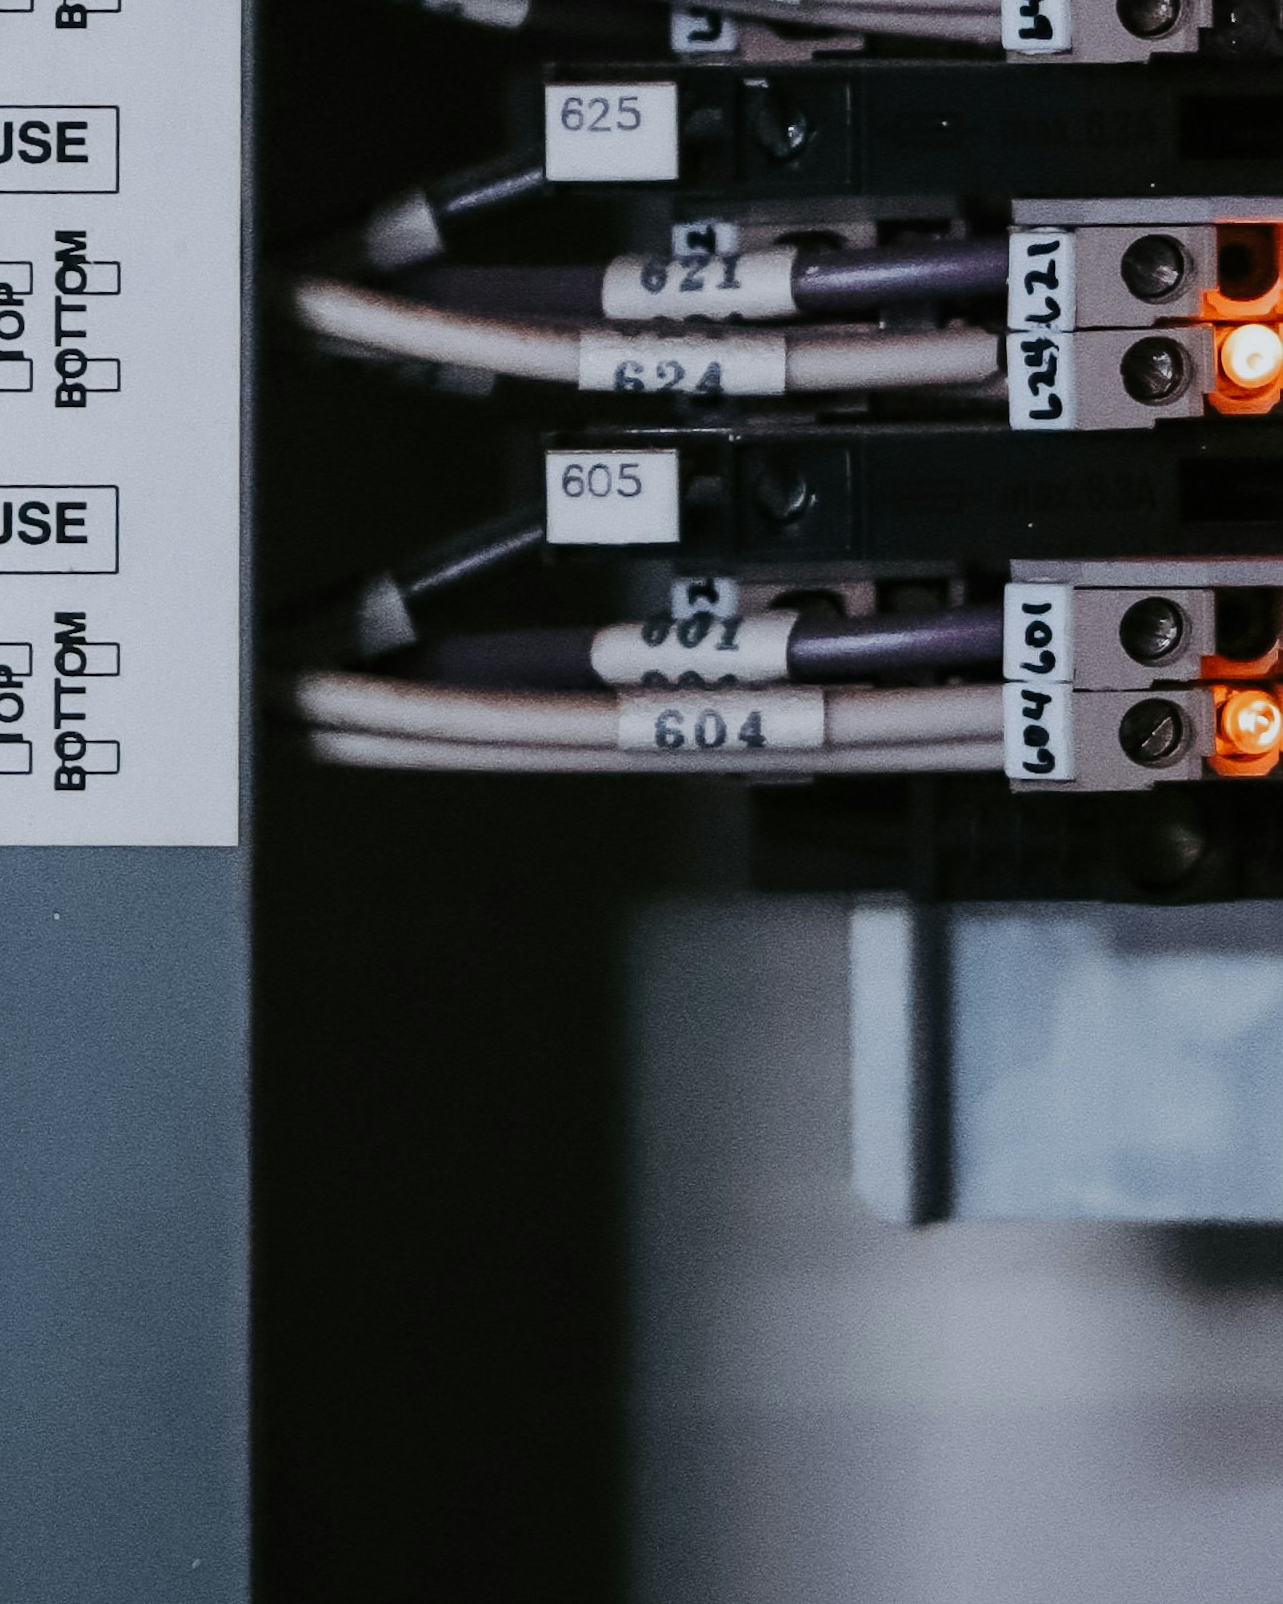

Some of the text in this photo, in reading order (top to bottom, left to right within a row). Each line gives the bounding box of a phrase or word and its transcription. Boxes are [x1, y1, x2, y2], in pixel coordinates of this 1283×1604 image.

[560, 96, 642, 134] 625
[55, 231, 86, 407] BOTTOM
[561, 463, 644, 499] 605
[1023, 603, 1057, 676] 601
[54, 612, 85, 791] BOTTOM
[654, 708, 766, 749] 604
[1020, 691, 1057, 776] 604
